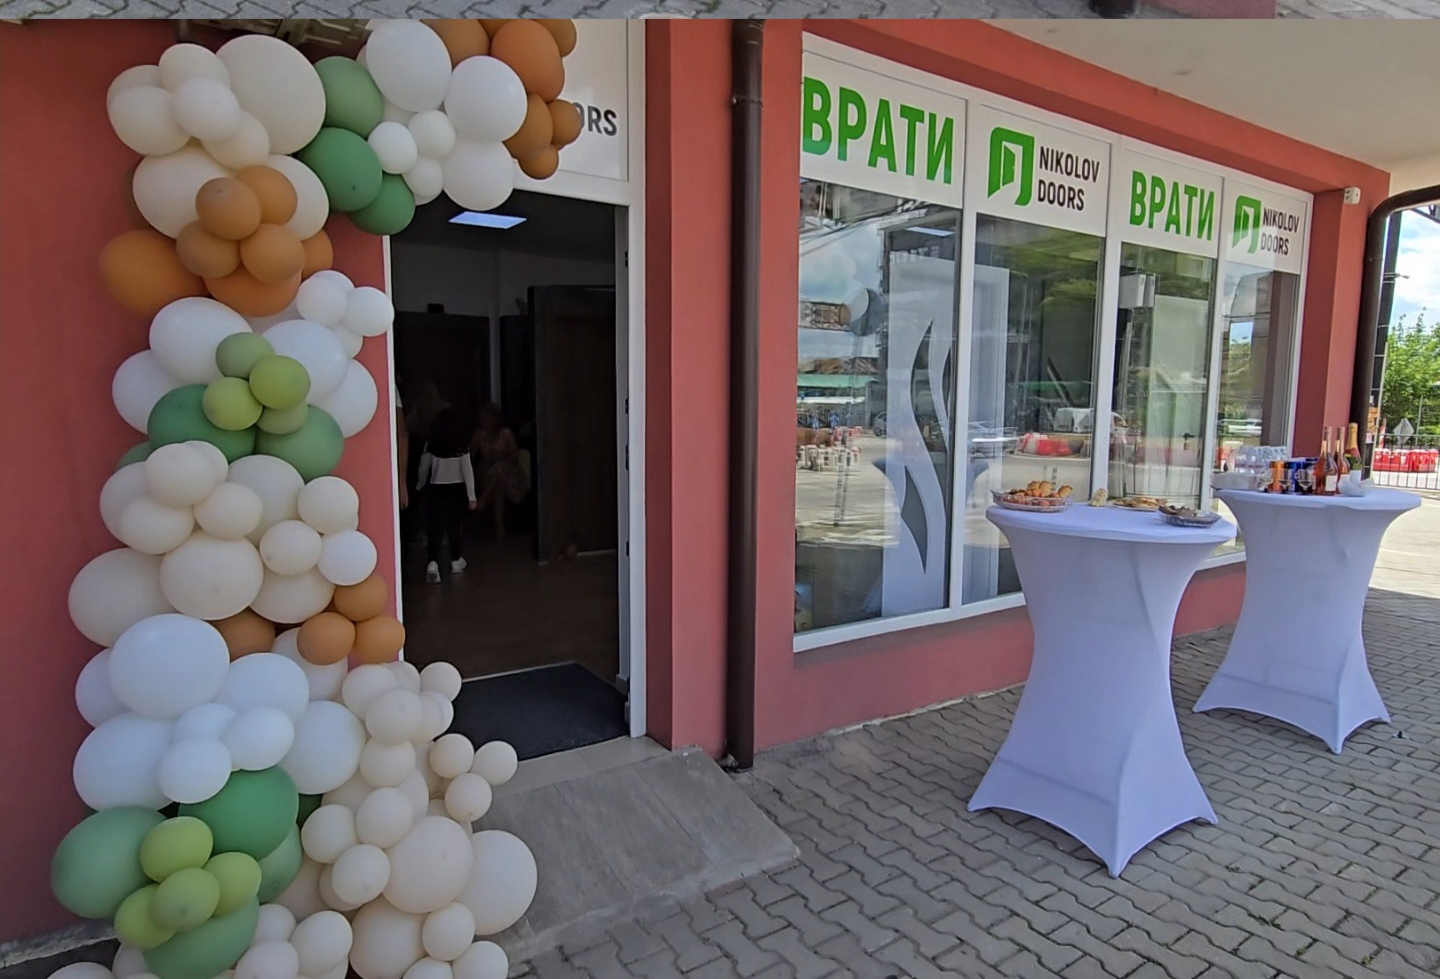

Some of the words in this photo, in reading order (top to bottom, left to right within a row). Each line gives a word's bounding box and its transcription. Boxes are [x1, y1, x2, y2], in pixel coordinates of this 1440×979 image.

[802, 76, 955, 184] ВРАТИ
[1039, 146, 1100, 183] NIKOLOV
[1038, 180, 1085, 211] DOORS
[1129, 170, 1215, 241] ВРАТИ
[1263, 208, 1300, 233] NIKOLOV
[1260, 232, 1290, 256] DOORS
